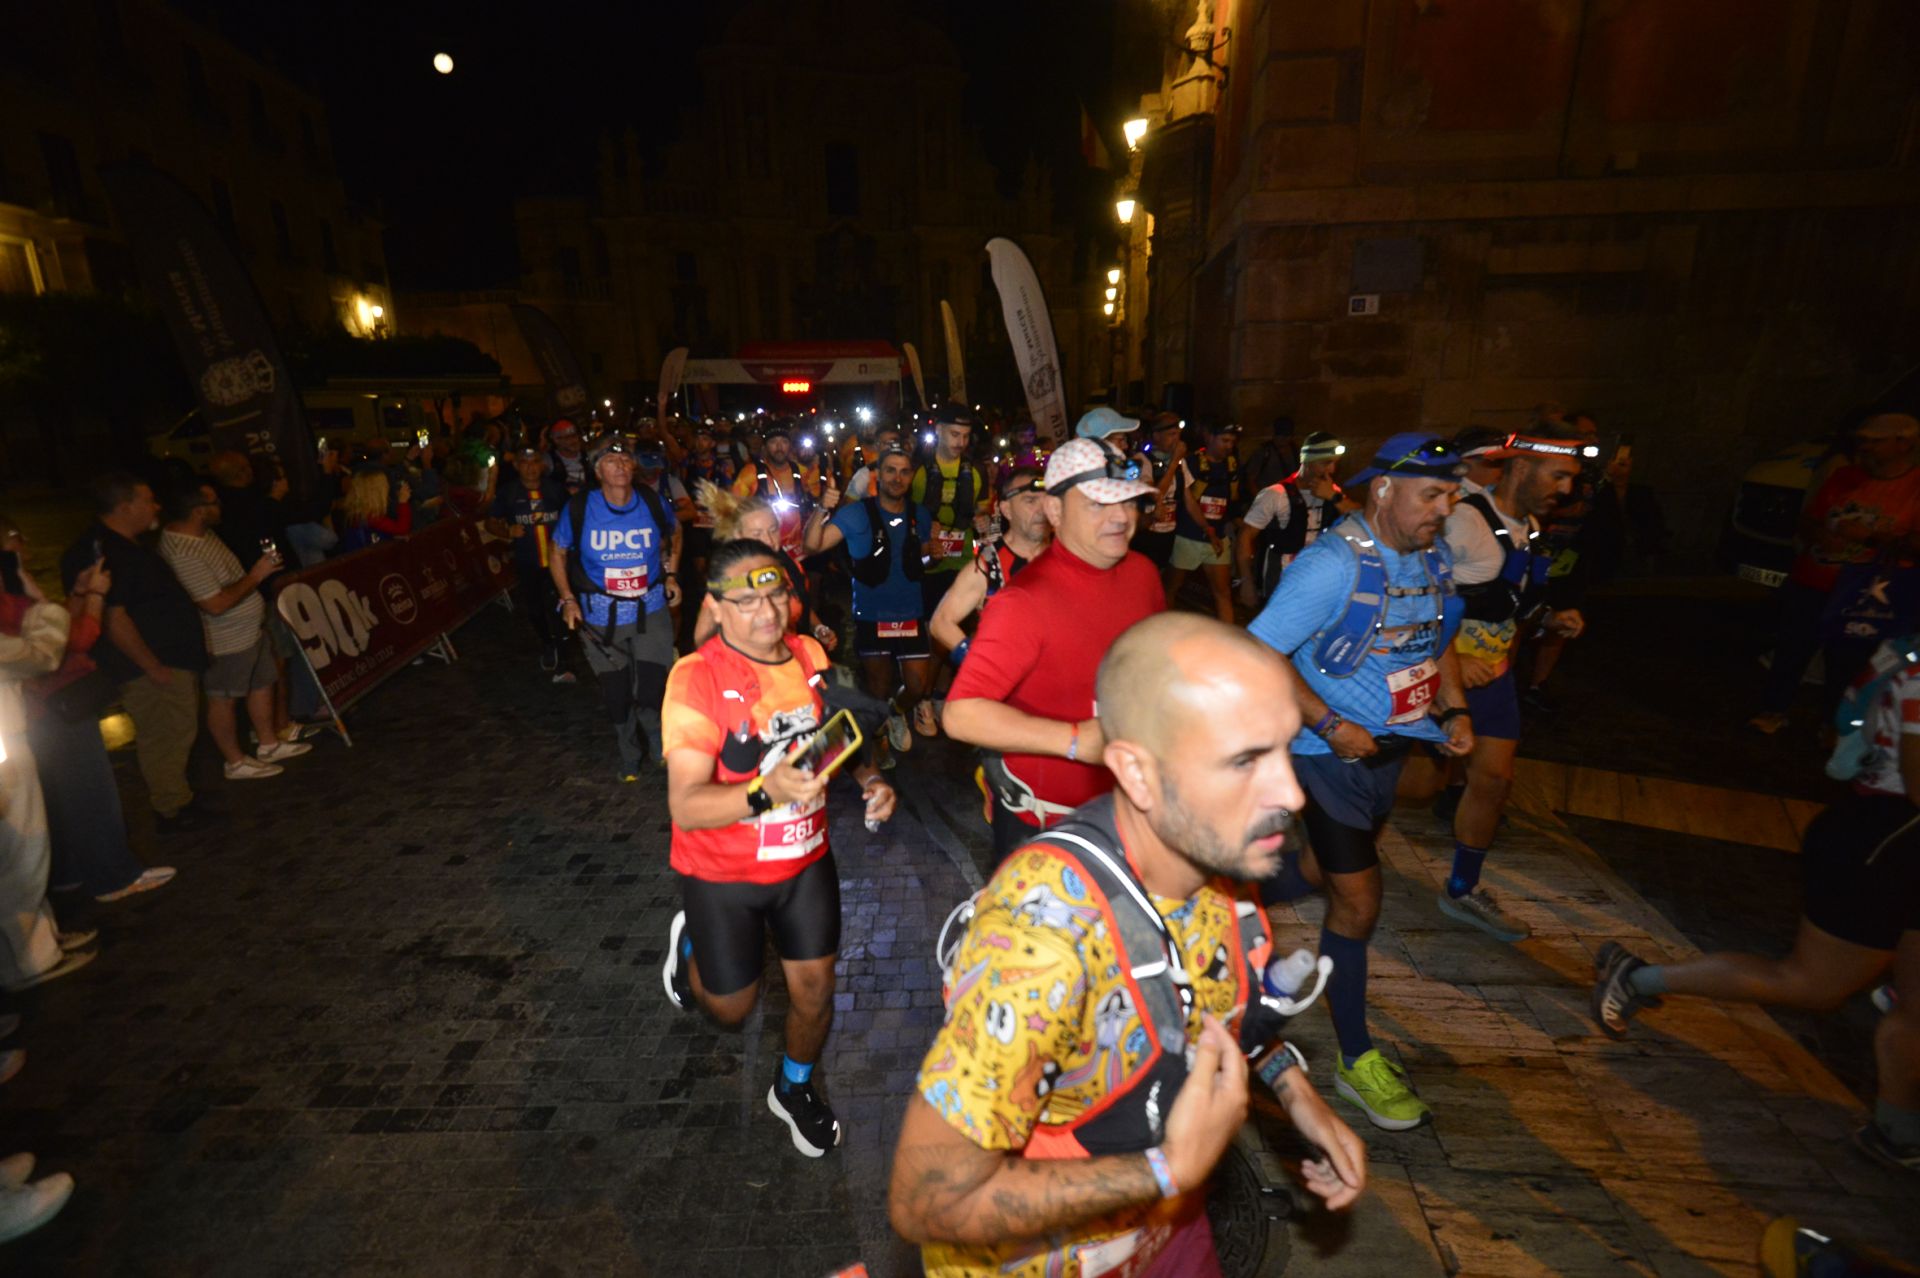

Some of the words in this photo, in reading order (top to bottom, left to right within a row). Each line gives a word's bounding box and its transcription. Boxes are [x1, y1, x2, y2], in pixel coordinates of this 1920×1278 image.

[590, 528, 653, 551] UPCT
[616, 578, 640, 590] 514
[1406, 683, 1432, 706] 451
[781, 818, 814, 844] 261
